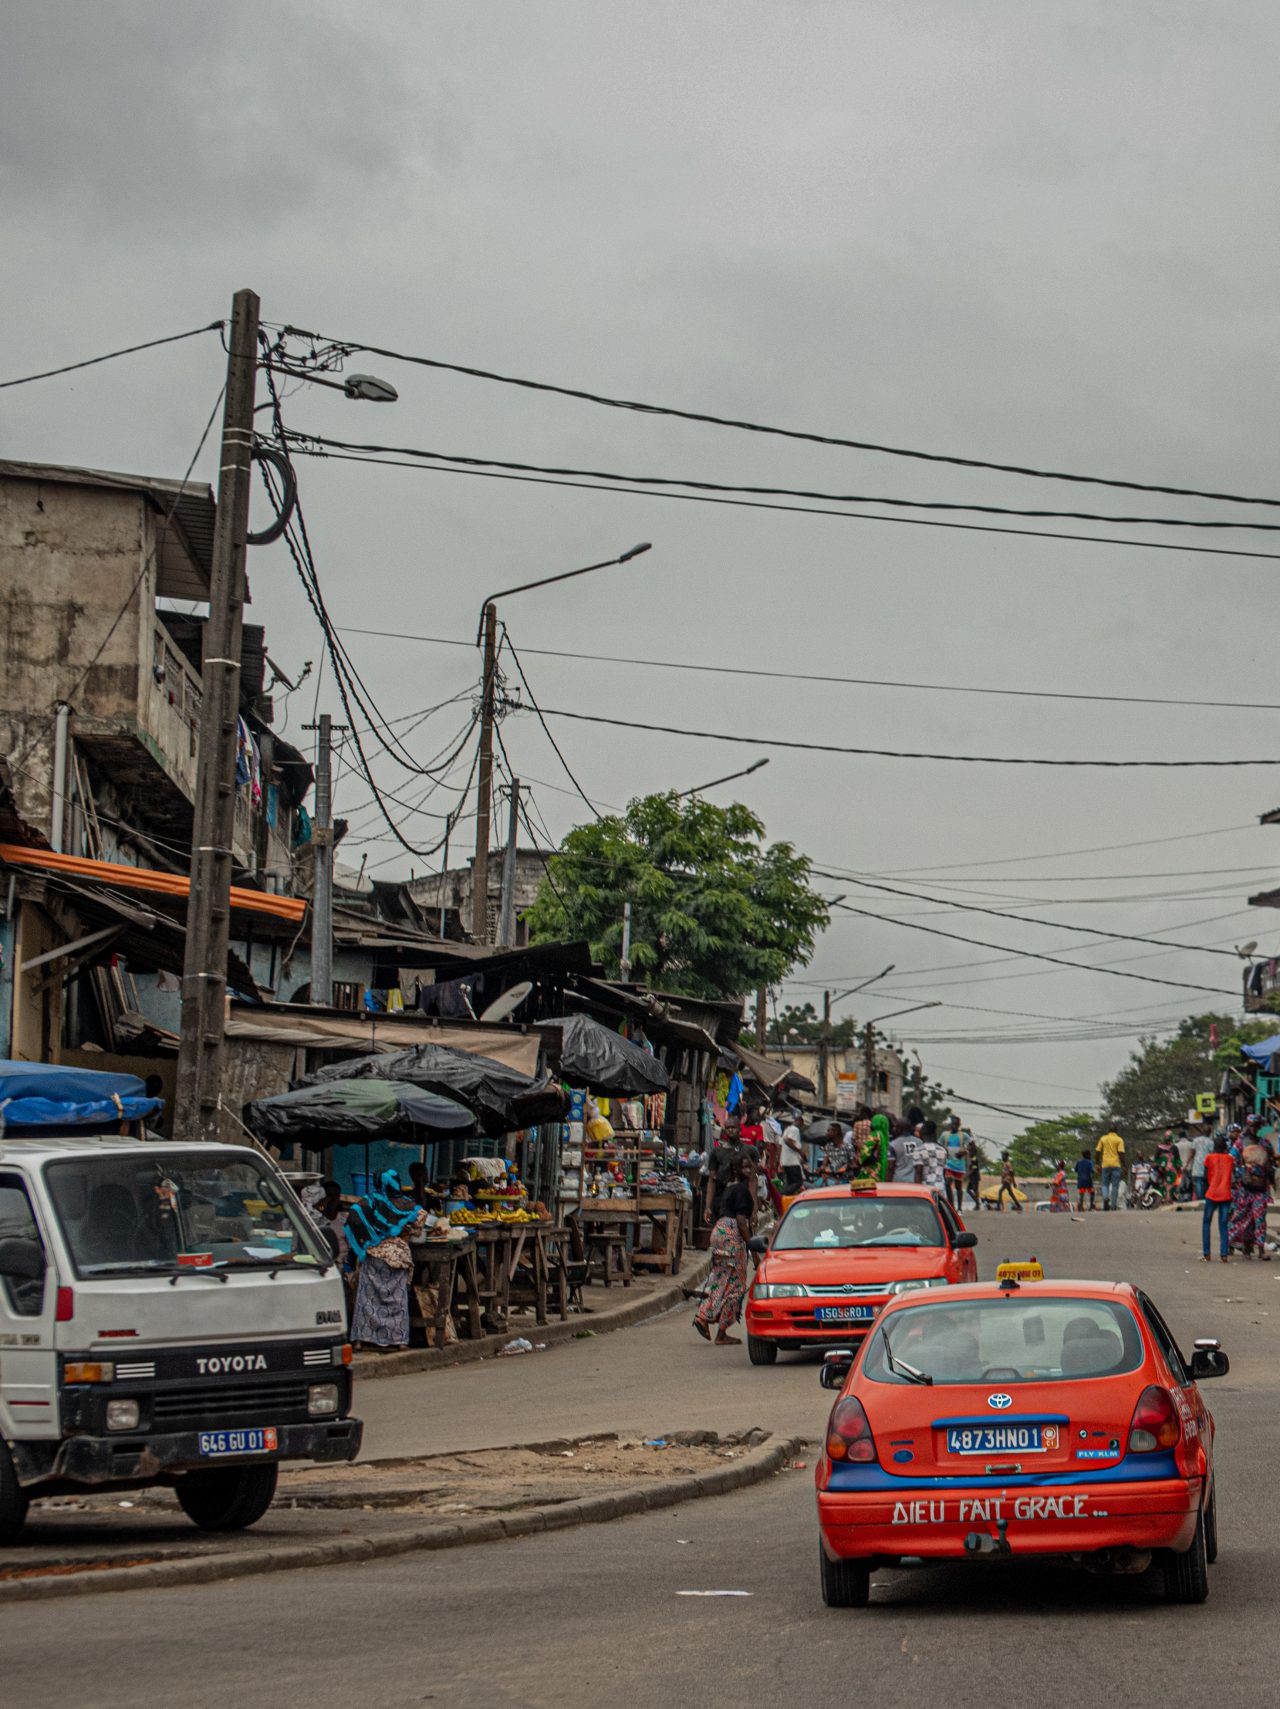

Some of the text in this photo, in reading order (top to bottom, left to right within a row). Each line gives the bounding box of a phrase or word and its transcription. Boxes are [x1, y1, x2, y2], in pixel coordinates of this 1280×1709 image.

[196, 1354, 268, 1374] TOYOTA
[201, 1434, 226, 1453] 646
[229, 1432, 245, 1450] GU
[248, 1431, 263, 1449] 01
[950, 1428, 1038, 1450] 4873HN01
[891, 1499, 945, 1525] DIEU
[959, 1496, 1006, 1522] FAIT
